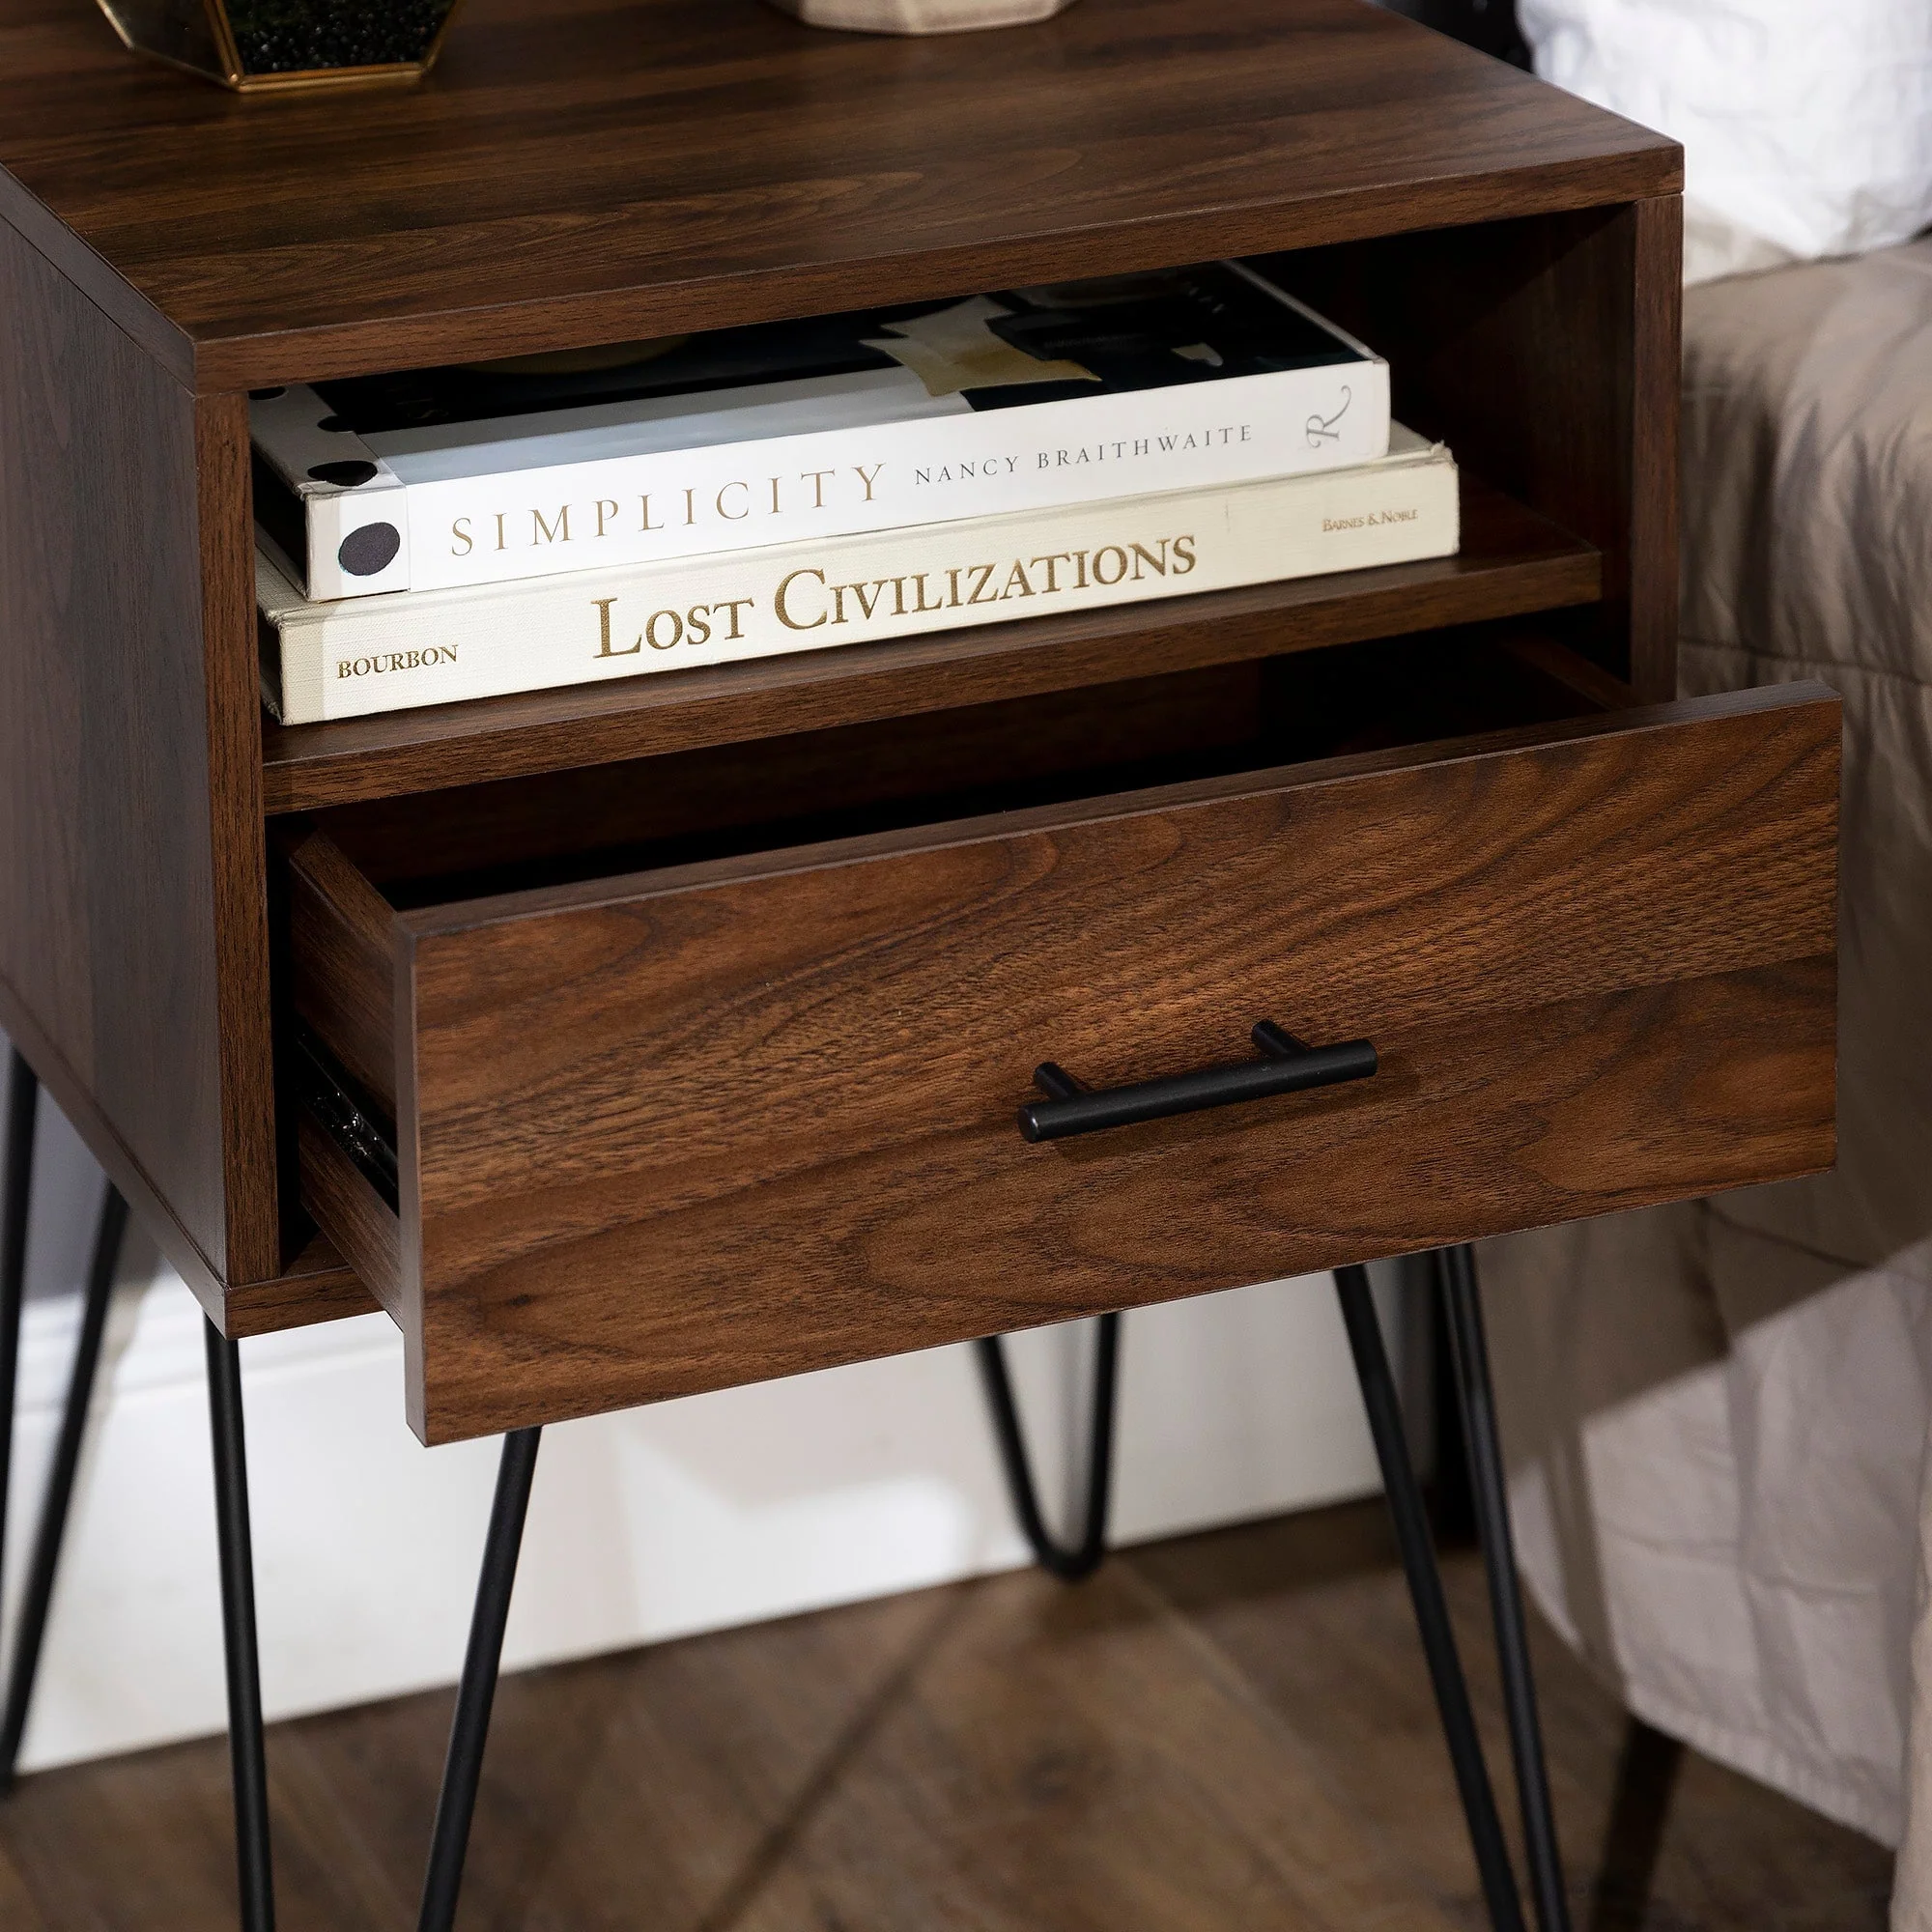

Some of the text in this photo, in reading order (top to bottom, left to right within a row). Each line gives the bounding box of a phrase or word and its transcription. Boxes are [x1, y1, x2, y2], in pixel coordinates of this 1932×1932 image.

[451, 424, 1254, 557] SIMPLICITY NANCY BRAITHWAITE
[1368, 513, 1380, 526] &
[590, 534, 1198, 659] LOST CIVILIZATIONS
[334, 643, 459, 679] BOURBON
